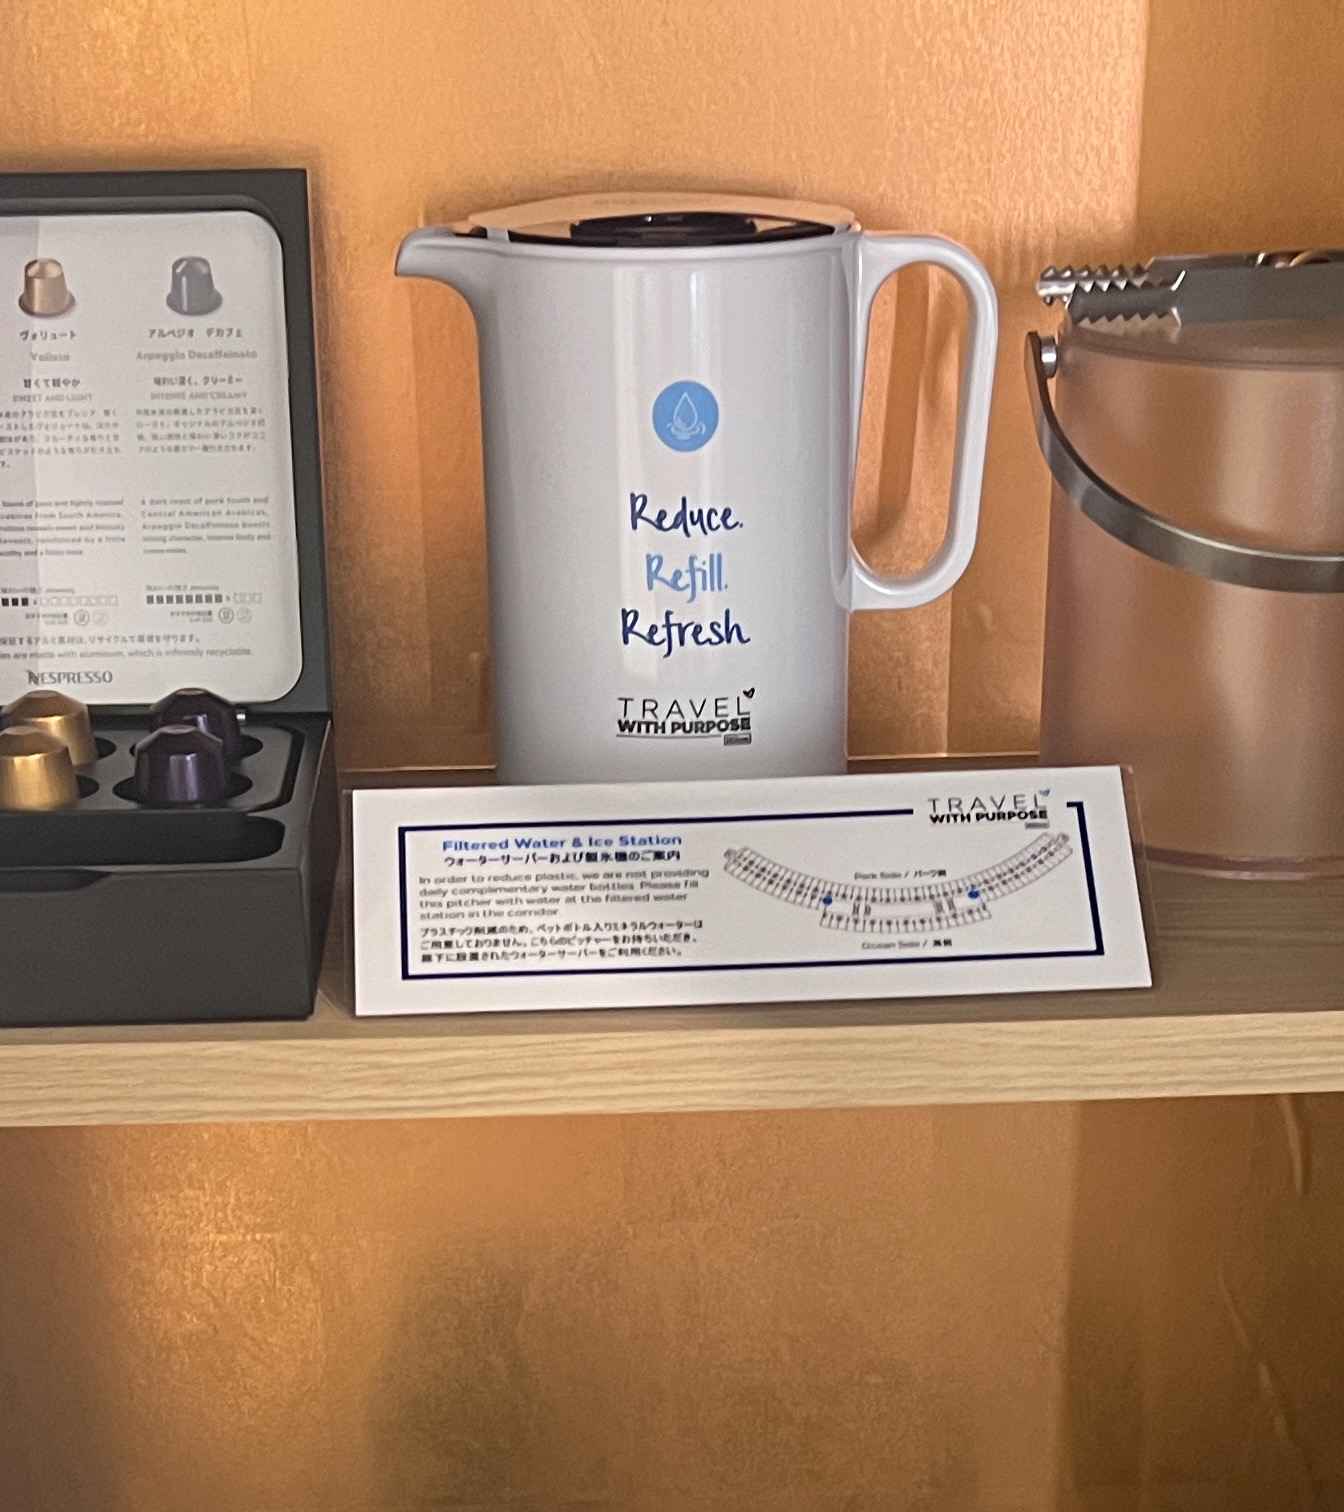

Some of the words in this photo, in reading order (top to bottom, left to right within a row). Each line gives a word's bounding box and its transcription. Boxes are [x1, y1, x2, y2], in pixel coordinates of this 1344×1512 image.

[136, 351, 186, 362] Arpeggio
[630, 492, 744, 538] Reduce.
[646, 552, 729, 604] Refill.
[25, 669, 114, 686] NESPRESSO
[617, 696, 751, 719] TRAVEL
[617, 719, 666, 734] WITH
[670, 717, 752, 734] PURPOSE
[927, 793, 1047, 814] TRAVEL
[929, 812, 971, 824] WITH
[975, 810, 1048, 822] PURPOSE
[443, 838, 509, 851] Filtered
[514, 837, 566, 849] Water
[572, 836, 583, 848] &
[588, 836, 614, 847] Ice
[619, 835, 682, 847] Station
[419, 876, 431, 884] In
[434, 875, 467, 884] order
[471, 875, 485, 883] to
[488, 873, 532, 882] reduce
[625, 870, 647, 879] not
[651, 869, 710, 880] providing
[419, 888, 448, 898] daily
[451, 885, 548, 896] complimentary
[551, 883, 586, 892] water
[640, 880, 681, 890] Please
[419, 900, 443, 909] this
[446, 898, 492, 909] pitcher
[495, 897, 523, 906] with
[525, 897, 561, 905] water
[565, 896, 577, 904] at
[580, 895, 602, 904] the
[605, 893, 650, 903] filtered
[653, 893, 688, 902] water
[420, 911, 465, 920] station
[468, 911, 480, 919] in
[482, 909, 505, 918] the
